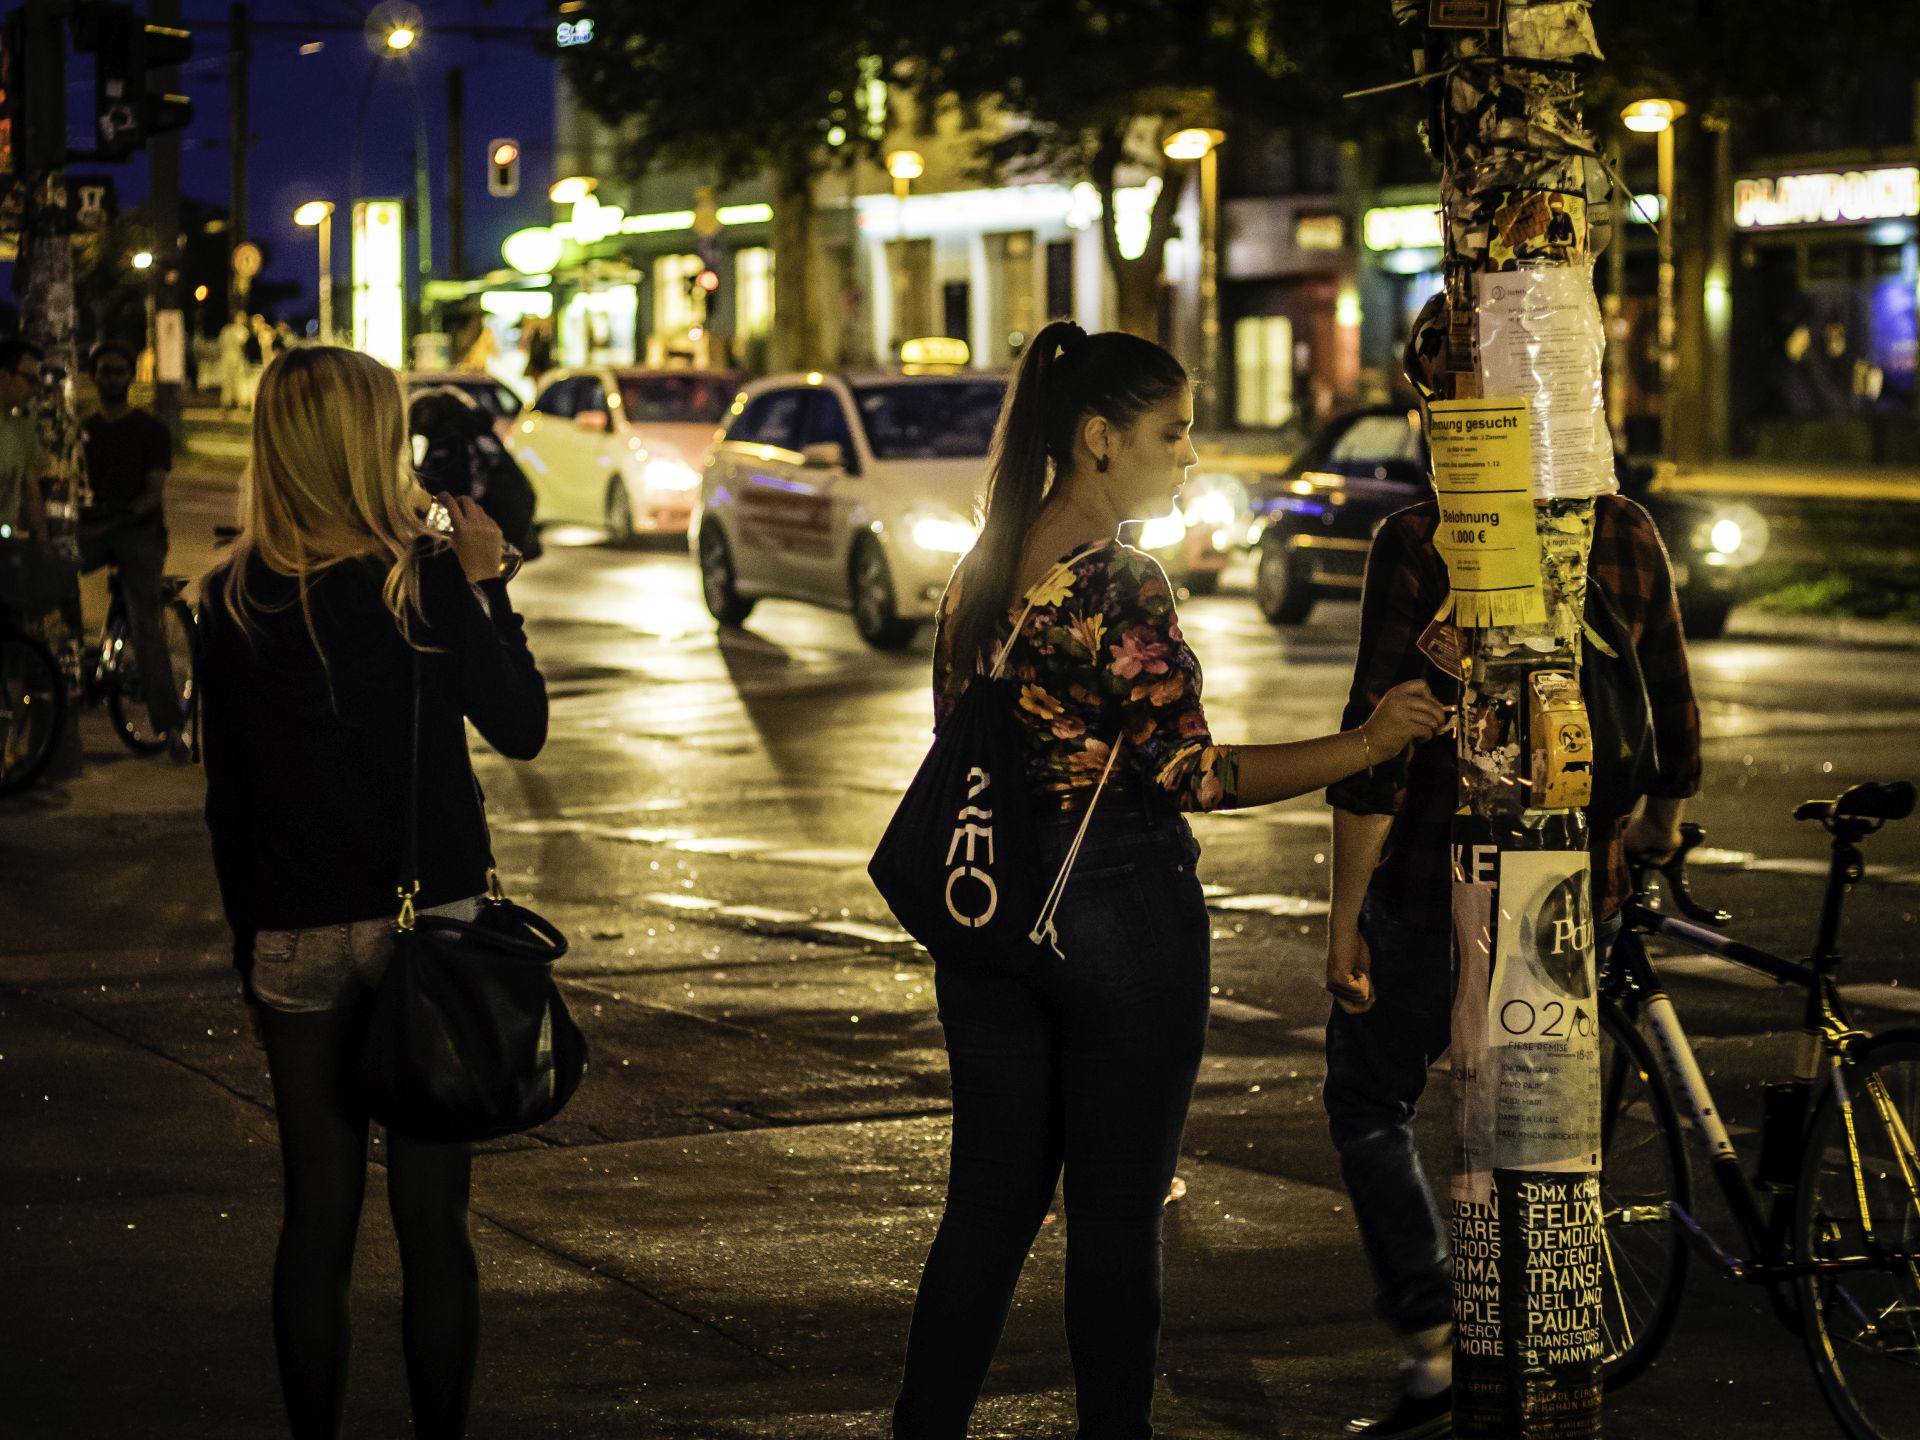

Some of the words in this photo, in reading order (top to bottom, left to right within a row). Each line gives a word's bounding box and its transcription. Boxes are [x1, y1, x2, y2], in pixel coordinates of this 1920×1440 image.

[1466, 415, 1518, 433] gesucht
[1443, 509, 1500, 526] Belohnung
[1452, 529, 1475, 543] 1.000
[1478, 529, 1487, 543] €
[1527, 1184, 1567, 1202] DMX
[1528, 1201, 1594, 1228] FELIX
[1527, 1224, 1600, 1250] DEMDIK
[1526, 1246, 1594, 1268] ANCIENT
[1527, 1293, 1569, 1310] NEIL
[1528, 1308, 1590, 1333] PAULA
[1459, 1324, 1501, 1338] MERCY
[1460, 1339, 1504, 1356] MORE
[1548, 1345, 1588, 1364] MANY
